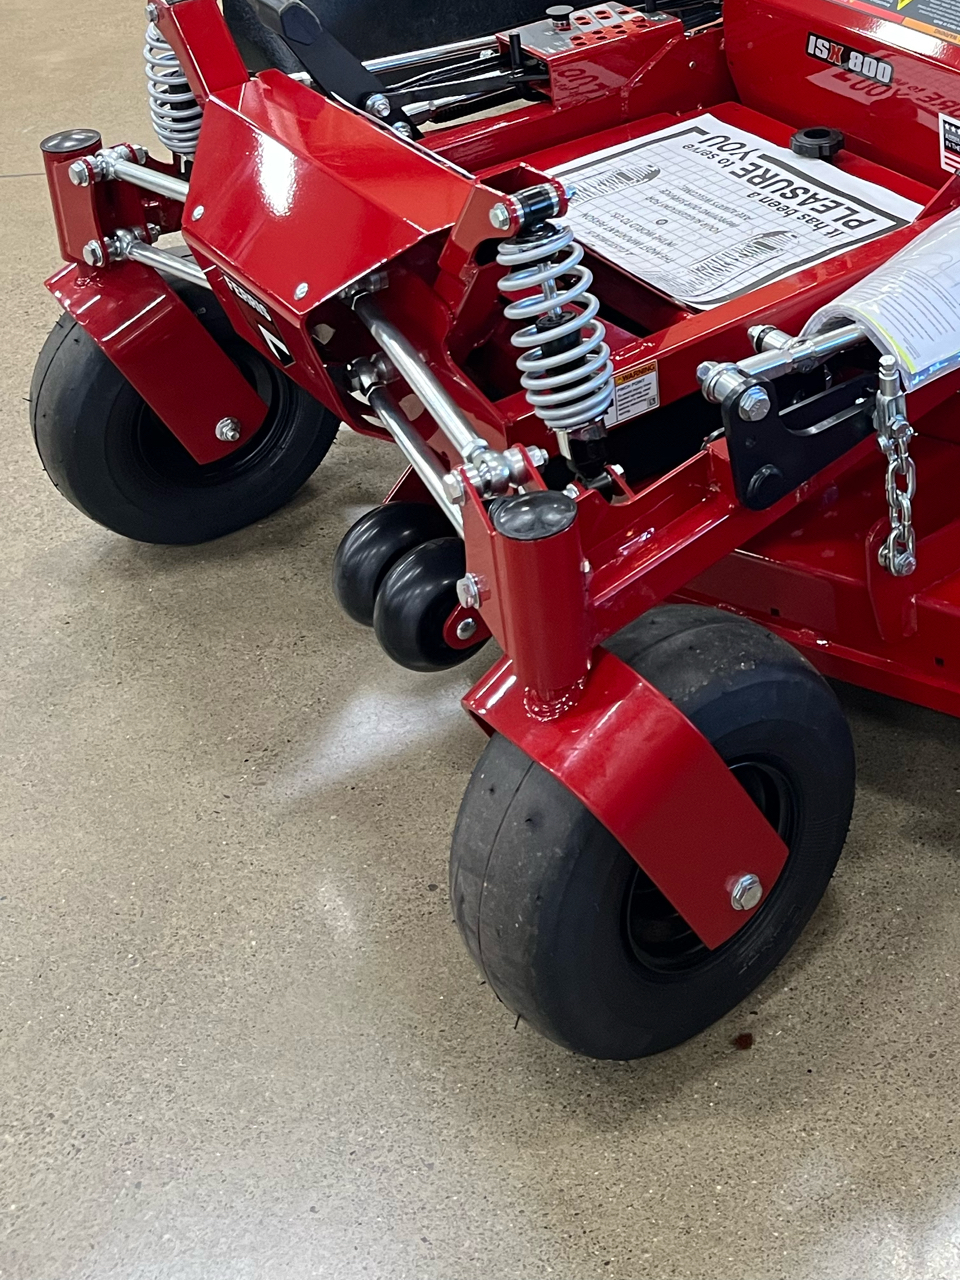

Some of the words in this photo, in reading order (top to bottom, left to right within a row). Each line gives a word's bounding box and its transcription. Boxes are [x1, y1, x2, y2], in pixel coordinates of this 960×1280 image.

[933, 29, 958, 39] WARNING
[807, 35, 844, 65] ISX
[848, 51, 892, 83] 800
[682, 143, 719, 160] serve
[698, 135, 760, 161] YOU
[718, 160, 735, 168] to
[729, 162, 875, 230] PLEASURE
[759, 196, 799, 218] been
[797, 213, 828, 231] has
[824, 227, 844, 238] It
[223, 275, 272, 321] FERRIS
[623, 364, 654, 381] WARNING
